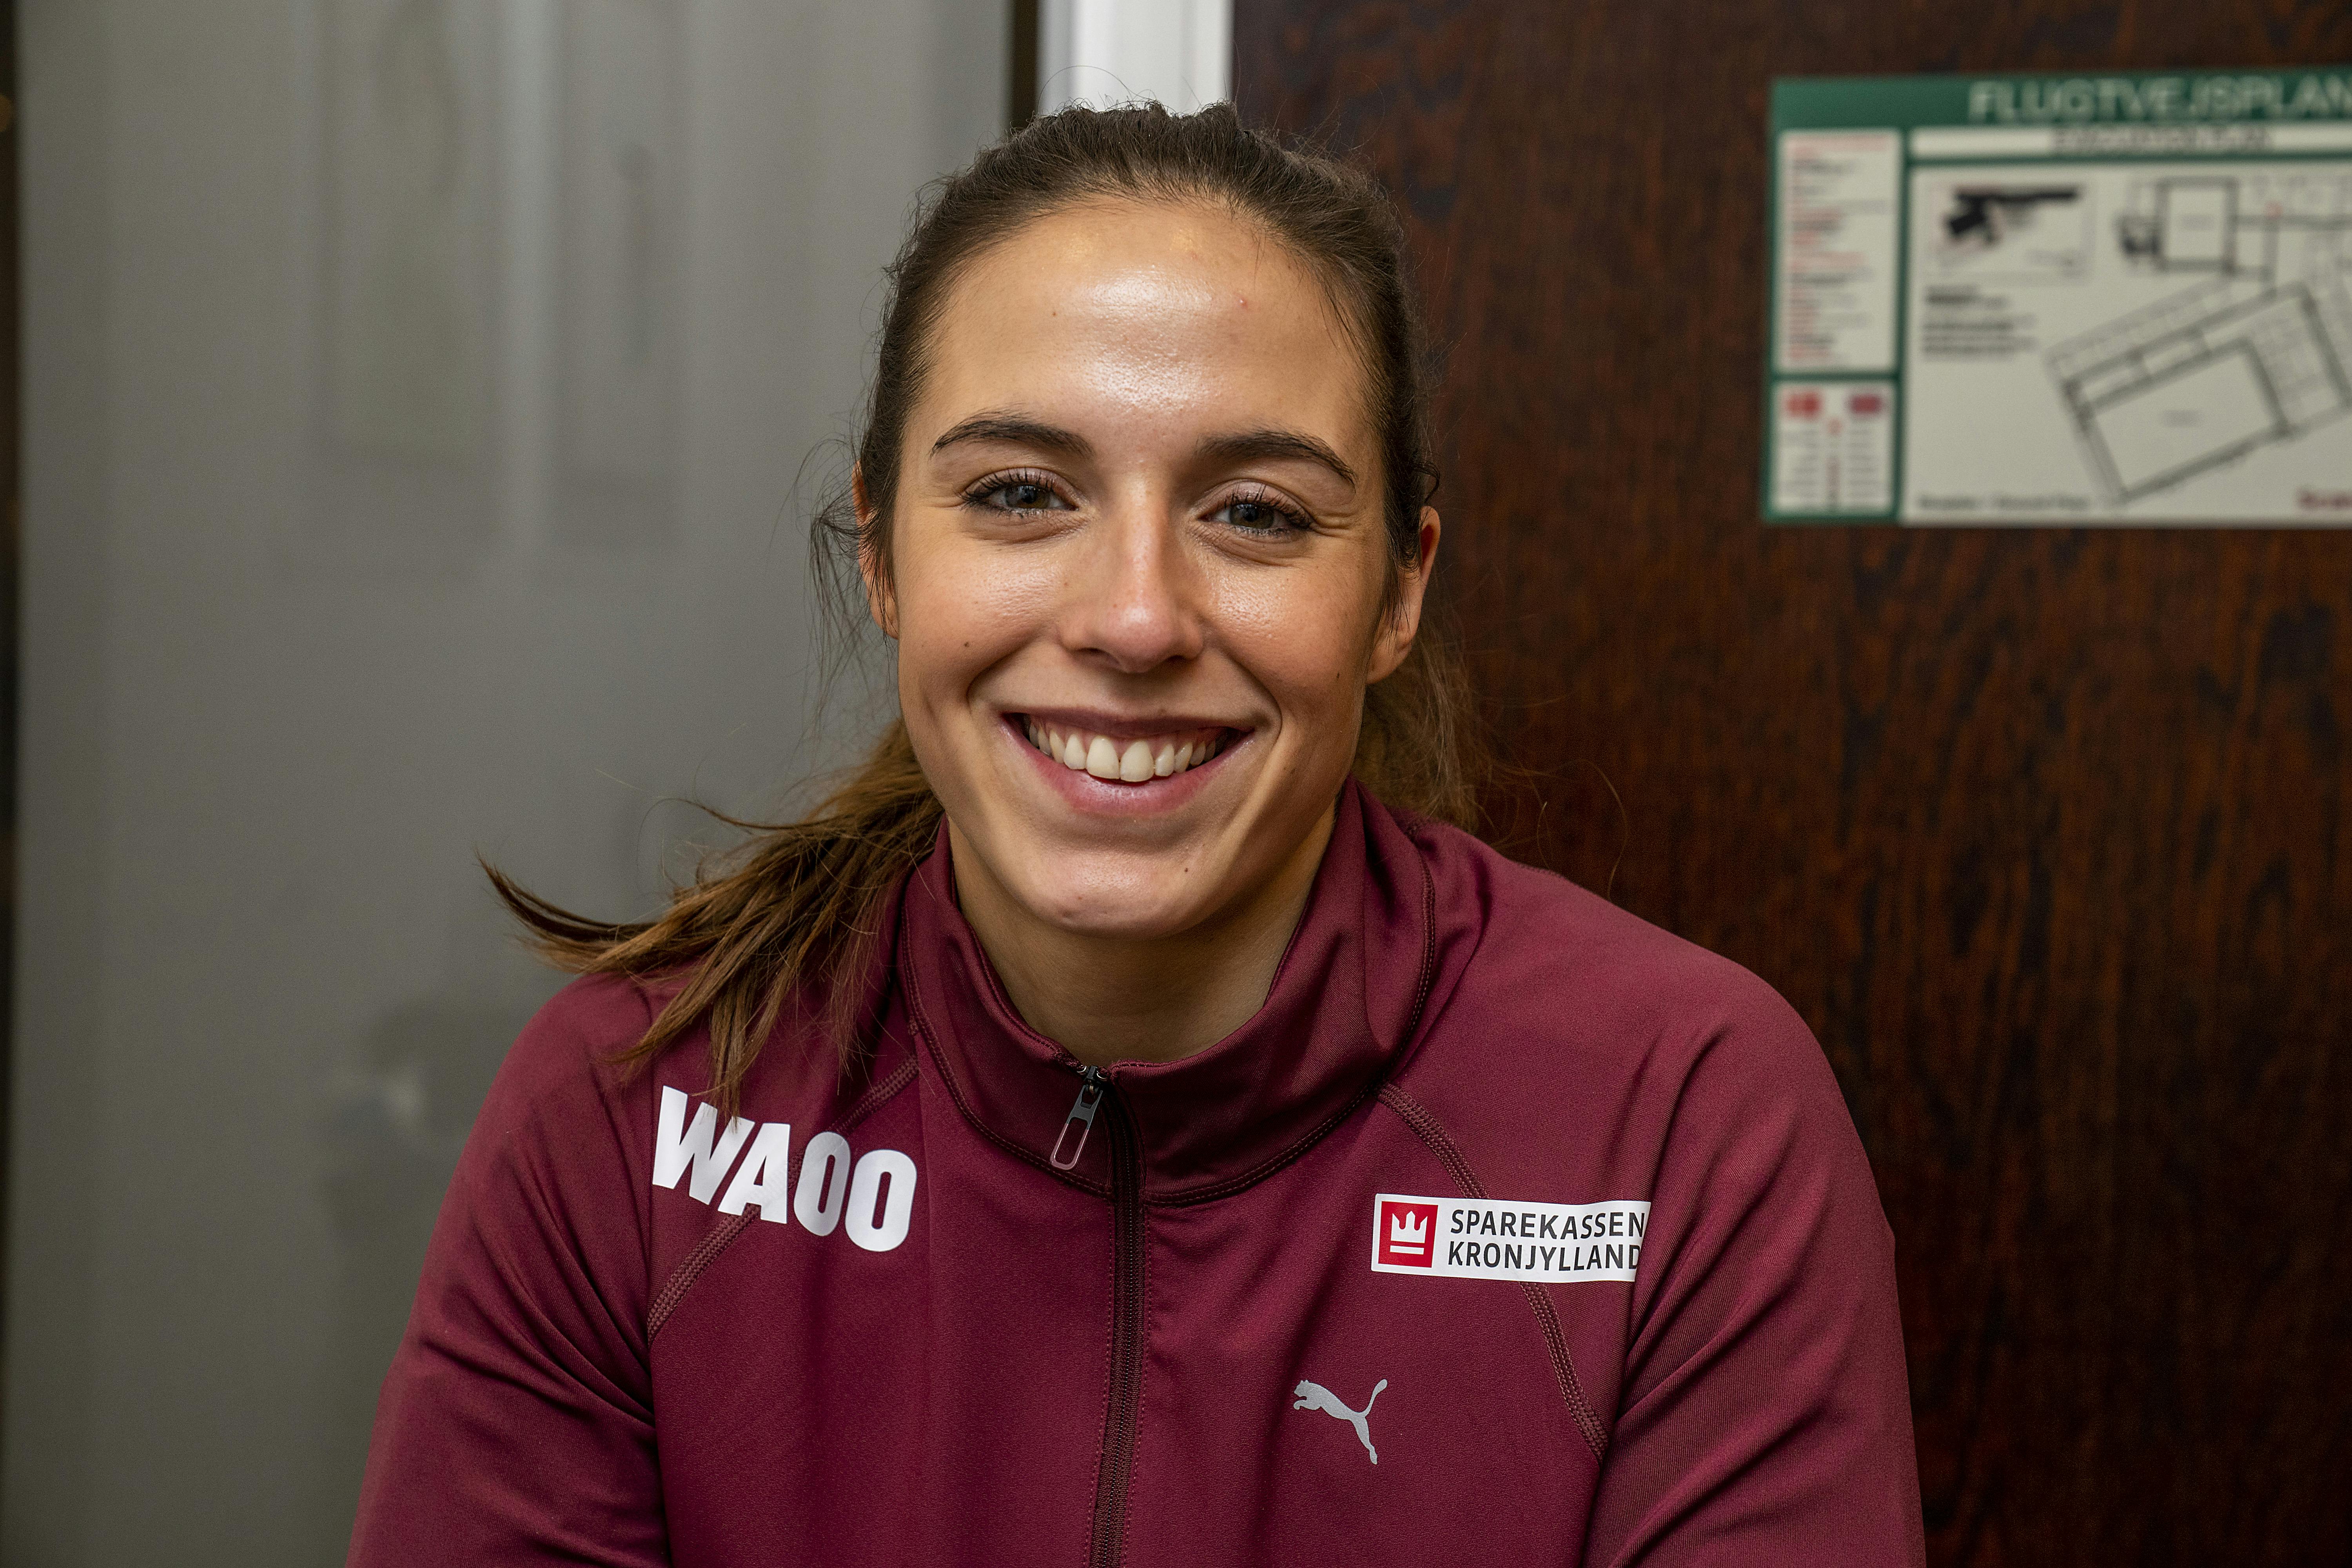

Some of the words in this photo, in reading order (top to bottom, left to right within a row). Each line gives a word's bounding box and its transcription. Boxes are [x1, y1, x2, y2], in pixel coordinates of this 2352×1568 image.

[652, 1085, 918, 1252] WAOO
[1450, 1209, 1645, 1240] SPAREKASSEN
[1448, 1241, 1641, 1271] KRONJYLLAND
